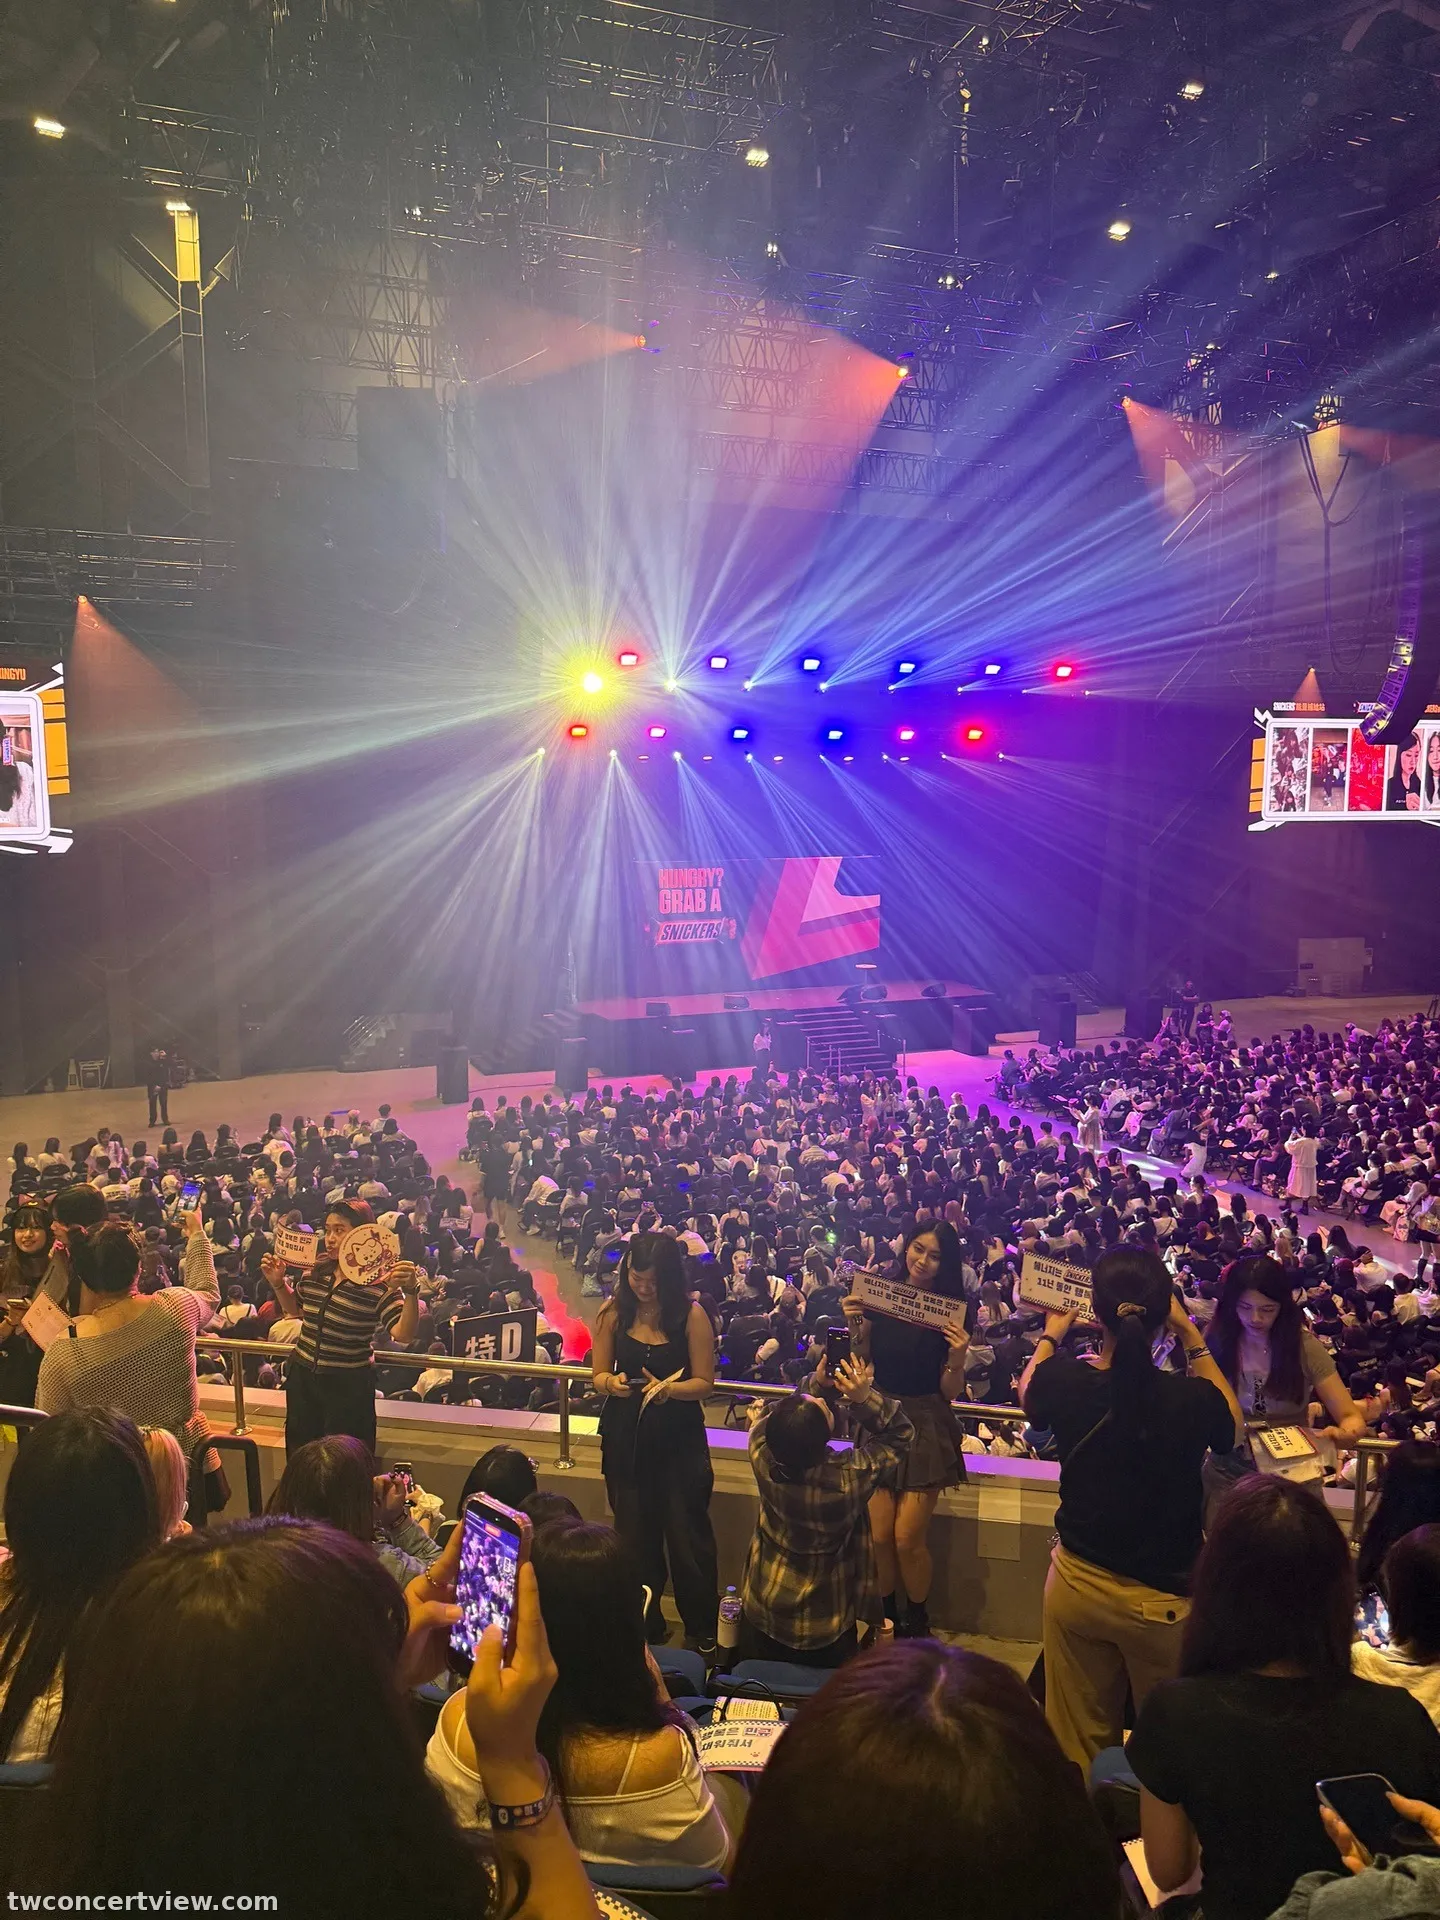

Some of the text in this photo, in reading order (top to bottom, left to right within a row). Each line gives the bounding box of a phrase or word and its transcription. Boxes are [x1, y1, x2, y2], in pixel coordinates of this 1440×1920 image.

[658, 867, 724, 889] HUNGRY?
[658, 889, 722, 914] GRAB A
[660, 919, 722, 941] SNICKERS
[744, 1727, 772, 1737] 민규
